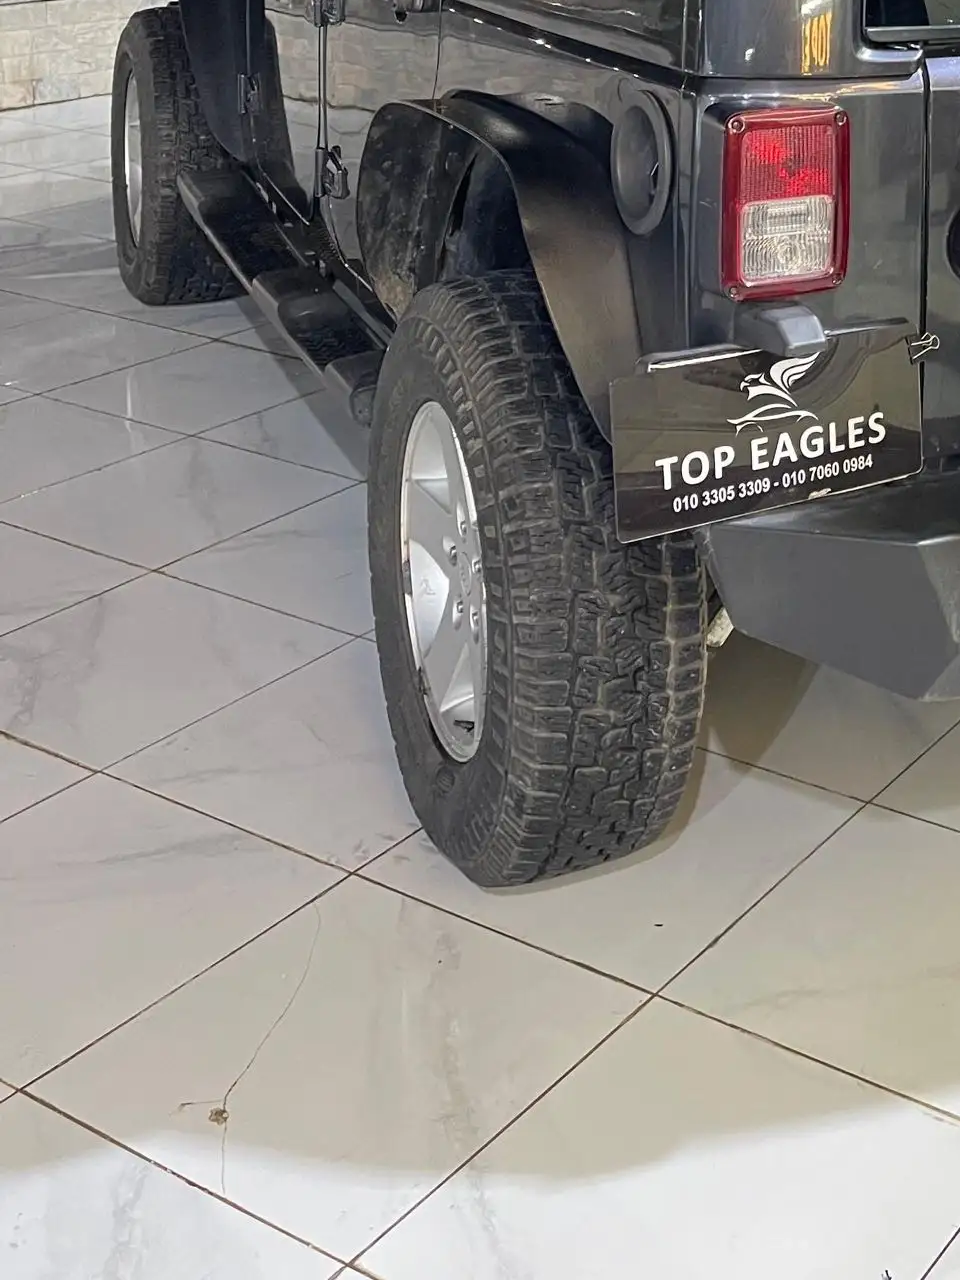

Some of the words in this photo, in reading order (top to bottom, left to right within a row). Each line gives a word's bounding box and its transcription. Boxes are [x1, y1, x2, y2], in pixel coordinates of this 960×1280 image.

[655, 445, 735, 491] TOP
[751, 412, 887, 472] EAGLES
[673, 494, 699, 513] 010
[702, 487, 736, 507] 3305
[738, 480, 770, 500] 3309
[781, 469, 806, 489] 010
[809, 462, 840, 483] 7060
[842, 454, 874, 474] 0984
